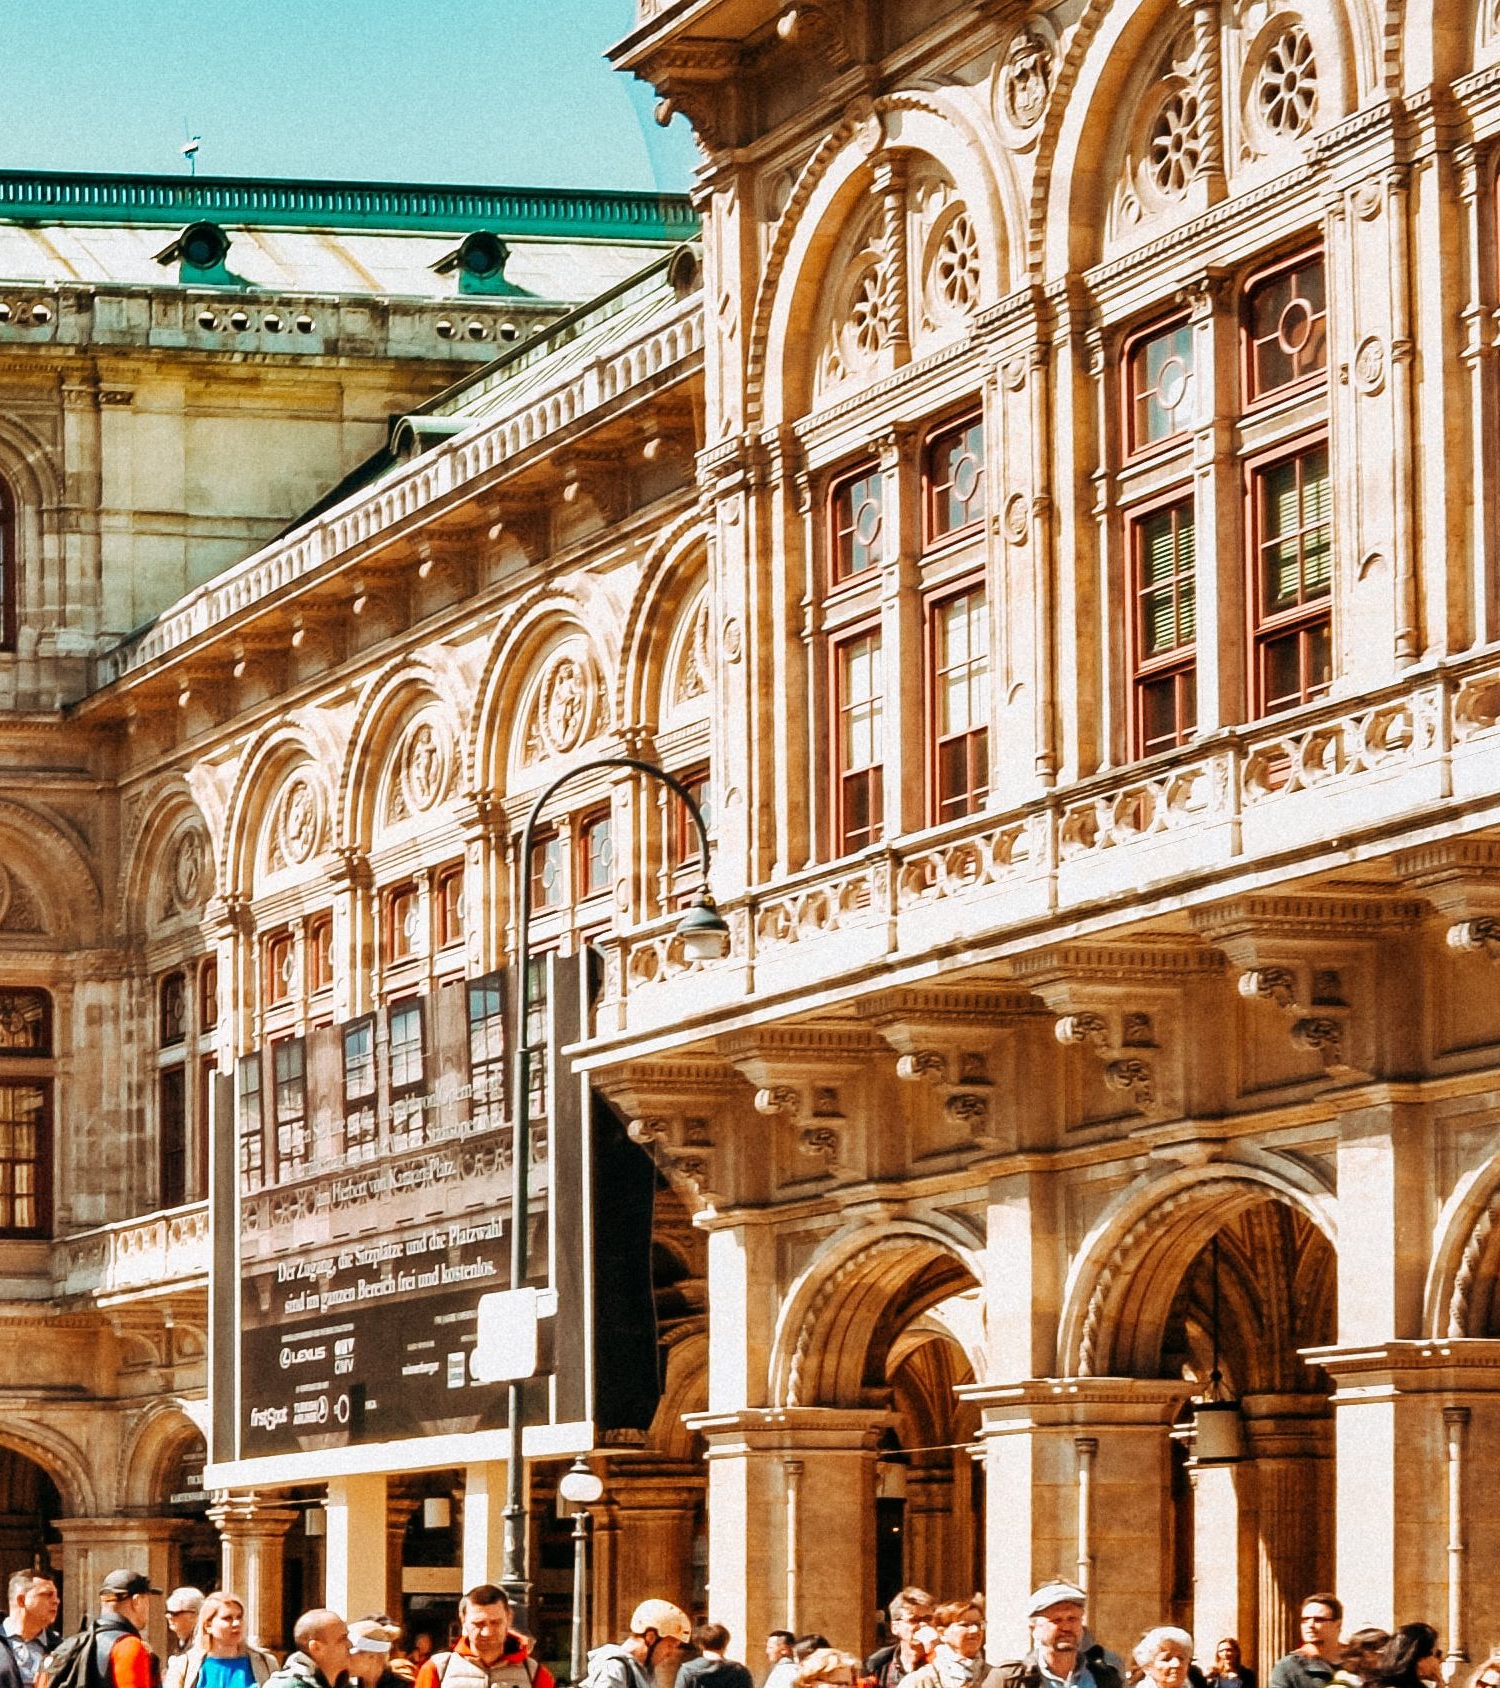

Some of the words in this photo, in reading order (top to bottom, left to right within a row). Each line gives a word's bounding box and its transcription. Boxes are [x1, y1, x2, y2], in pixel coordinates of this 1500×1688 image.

[277, 1262, 296, 1283] Der
[296, 1256, 337, 1282] Zugang,
[337, 1249, 354, 1269] die
[405, 1234, 426, 1256] und
[428, 1229, 447, 1251] die
[448, 1216, 504, 1247] Platzwahl
[357, 1274, 396, 1300] Bereich
[397, 1269, 416, 1292] frei
[417, 1264, 440, 1287] und
[291, 1346, 326, 1364] LEXUS
